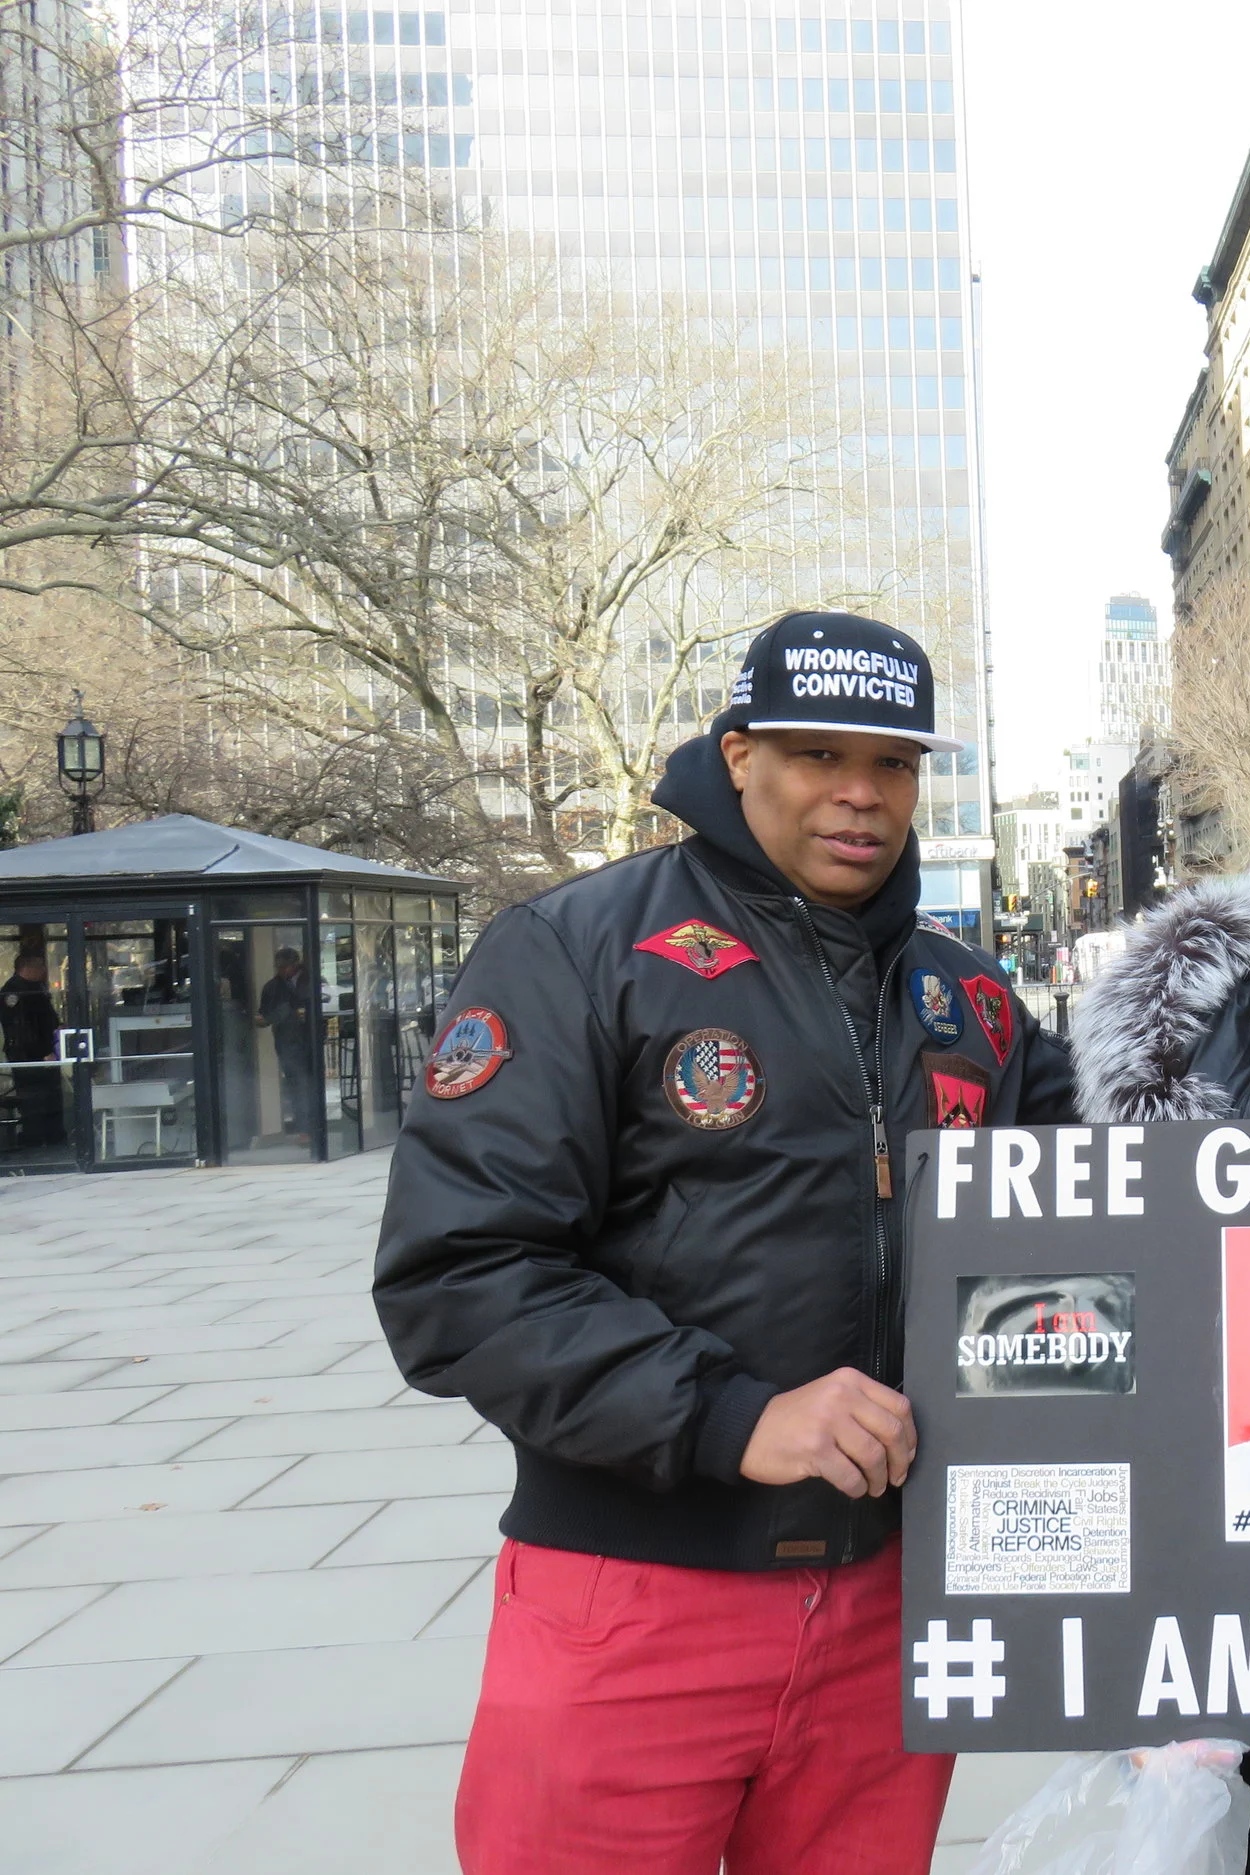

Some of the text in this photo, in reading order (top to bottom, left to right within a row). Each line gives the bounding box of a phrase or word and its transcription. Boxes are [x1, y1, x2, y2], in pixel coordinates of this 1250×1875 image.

[784, 648, 919, 685] WRONGFULLY
[792, 674, 915, 708] CONVICTED
[677, 1030, 748, 1052] OPERATION
[431, 1079, 474, 1095] HORNET
[937, 1127, 1145, 1219] FREE
[1033, 1302, 1097, 1333] I am
[957, 1331, 1132, 1367] SOMEBODY
[957, 1467, 1116, 1479] Sentencing Discretion Incarceration
[982, 1479, 1011, 1490] Unjust
[1014, 1478, 1086, 1490] Break the Cycle
[1087, 1478, 1119, 1489] Judges
[982, 1488, 1071, 1499] Reduce Recidivism
[1087, 1490, 1118, 1503] Jobs
[1118, 1466, 1128, 1515] Juveniles
[992, 1499, 1078, 1516] CRIMINAL
[1087, 1503, 1118, 1514] States
[947, 1470, 958, 1560] Background Checks
[969, 1479, 981, 1552] Alternatives
[1073, 1515, 1128, 1528] Civil Rights
[996, 1517, 1071, 1534] JUSTICE
[1082, 1527, 1127, 1537] Detention
[991, 1535, 1082, 1552] REFORMS
[1084, 1537, 1120, 1547] Barriers
[993, 1551, 1082, 1564] Records Expunged
[1082, 1555, 1121, 1565] Change
[947, 1561, 1002, 1574] Employers
[1069, 1561, 1098, 1573] Laws
[1013, 1572, 1047, 1582] Federal
[1050, 1571, 1091, 1583] Probation
[1094, 1572, 1117, 1582] Cost
[946, 1582, 980, 1592] Effective
[1062, 1616, 1085, 1718] I
